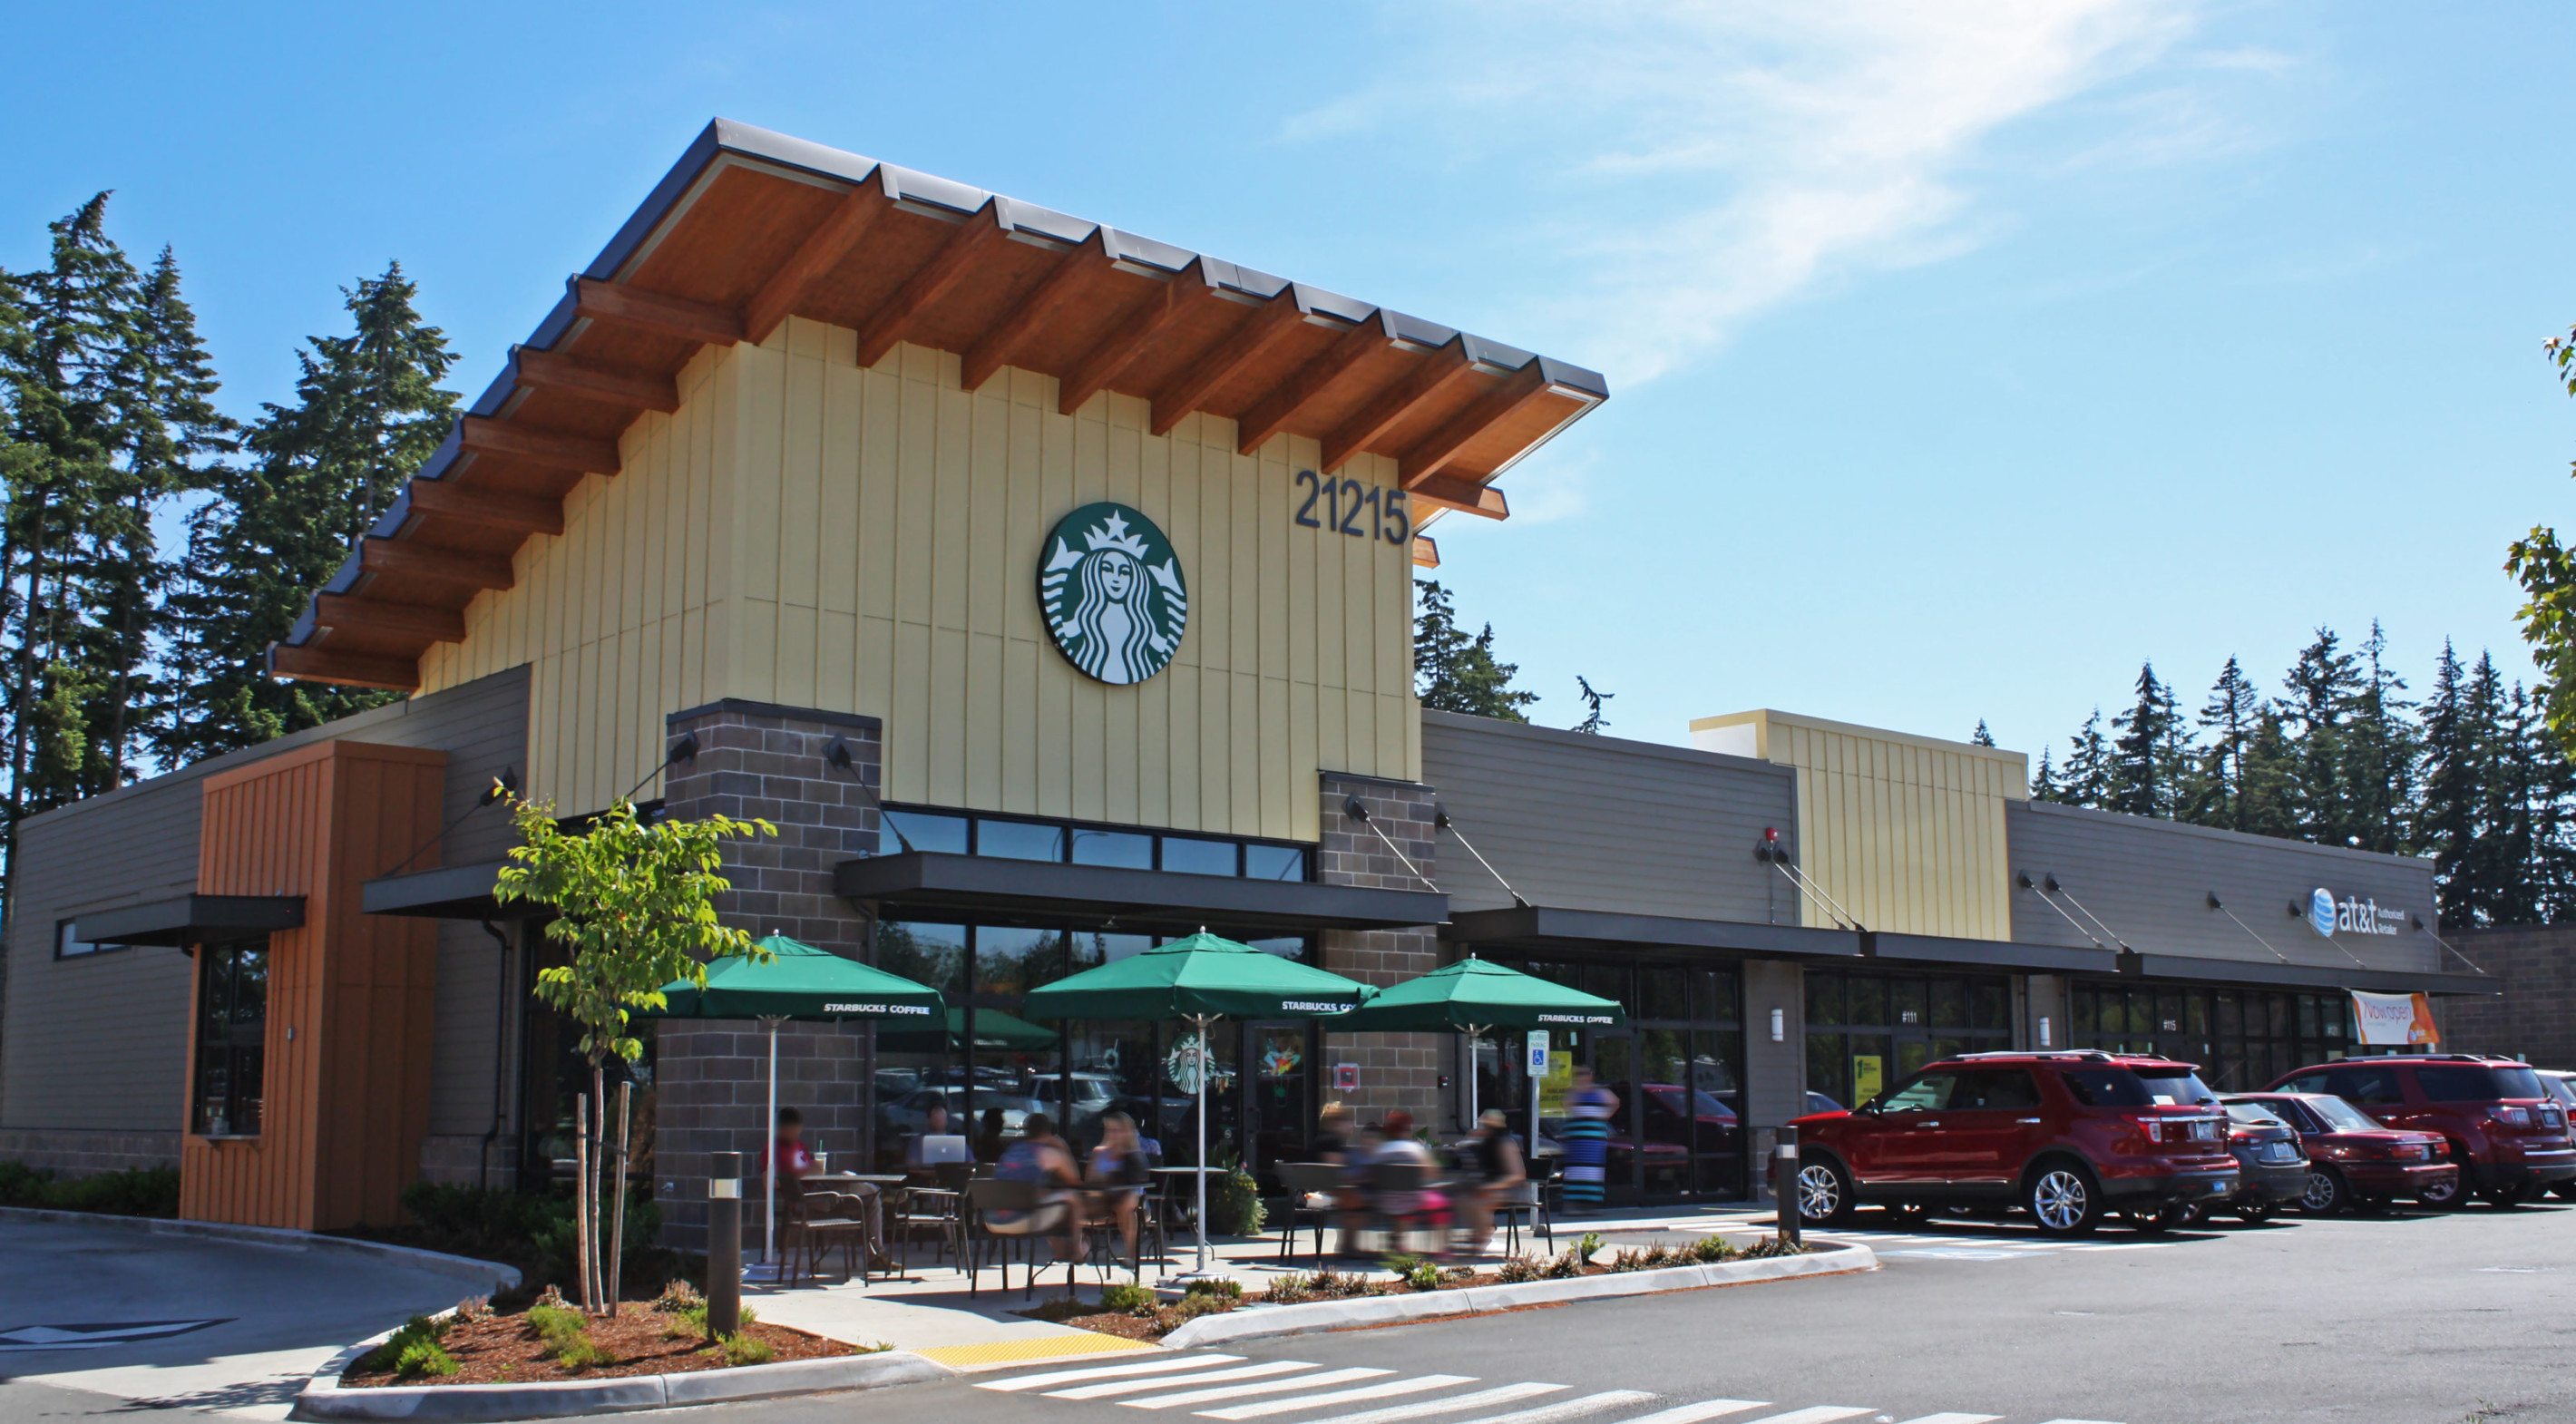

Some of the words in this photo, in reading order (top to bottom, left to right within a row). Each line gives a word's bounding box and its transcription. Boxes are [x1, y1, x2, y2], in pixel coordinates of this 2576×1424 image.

[1295, 470, 1409, 545] 21215
[2337, 895, 2377, 934] at&t
[824, 1003, 887, 1013] STARBUCKS
[889, 1005, 930, 1015] COFFEE
[1282, 1000, 1337, 1011] STARBUCKS
[2365, 1000, 2386, 1019] Now
[2387, 1006, 2412, 1025] open
[1537, 1014, 1585, 1023] STARBUCKS
[1586, 1016, 1614, 1024] COFFEE
